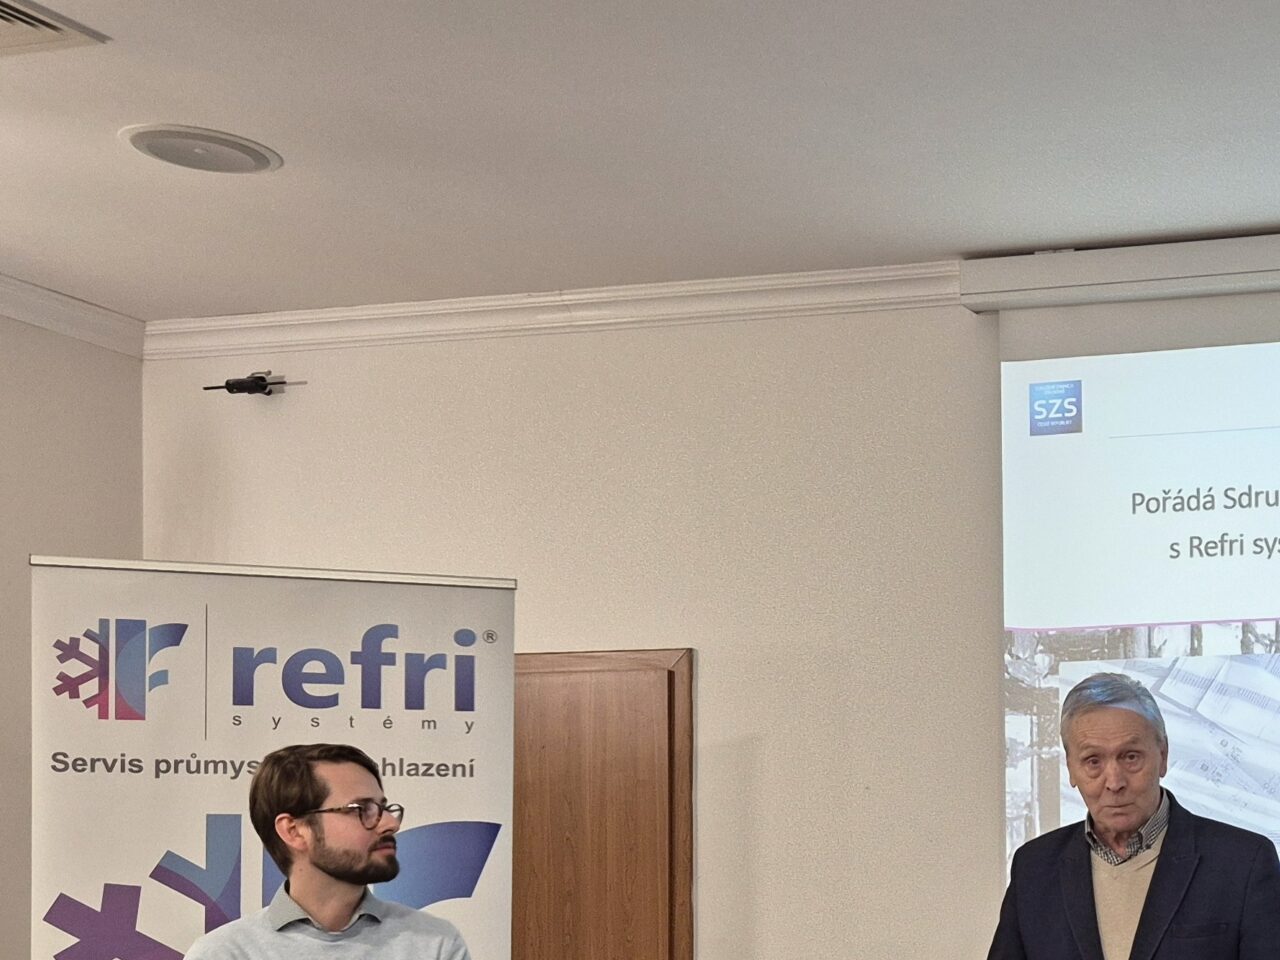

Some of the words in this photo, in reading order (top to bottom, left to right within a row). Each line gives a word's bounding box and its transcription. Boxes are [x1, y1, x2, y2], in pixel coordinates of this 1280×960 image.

[1033, 397, 1078, 420] SZS
[1131, 486, 1215, 515] Pořádá
[1169, 541, 1181, 559] s
[1189, 532, 1244, 559] Refri
[231, 713, 475, 734] systémy
[50, 751, 144, 774] Servis
[154, 752, 260, 779] průmys
[381, 757, 475, 778] hlazení
